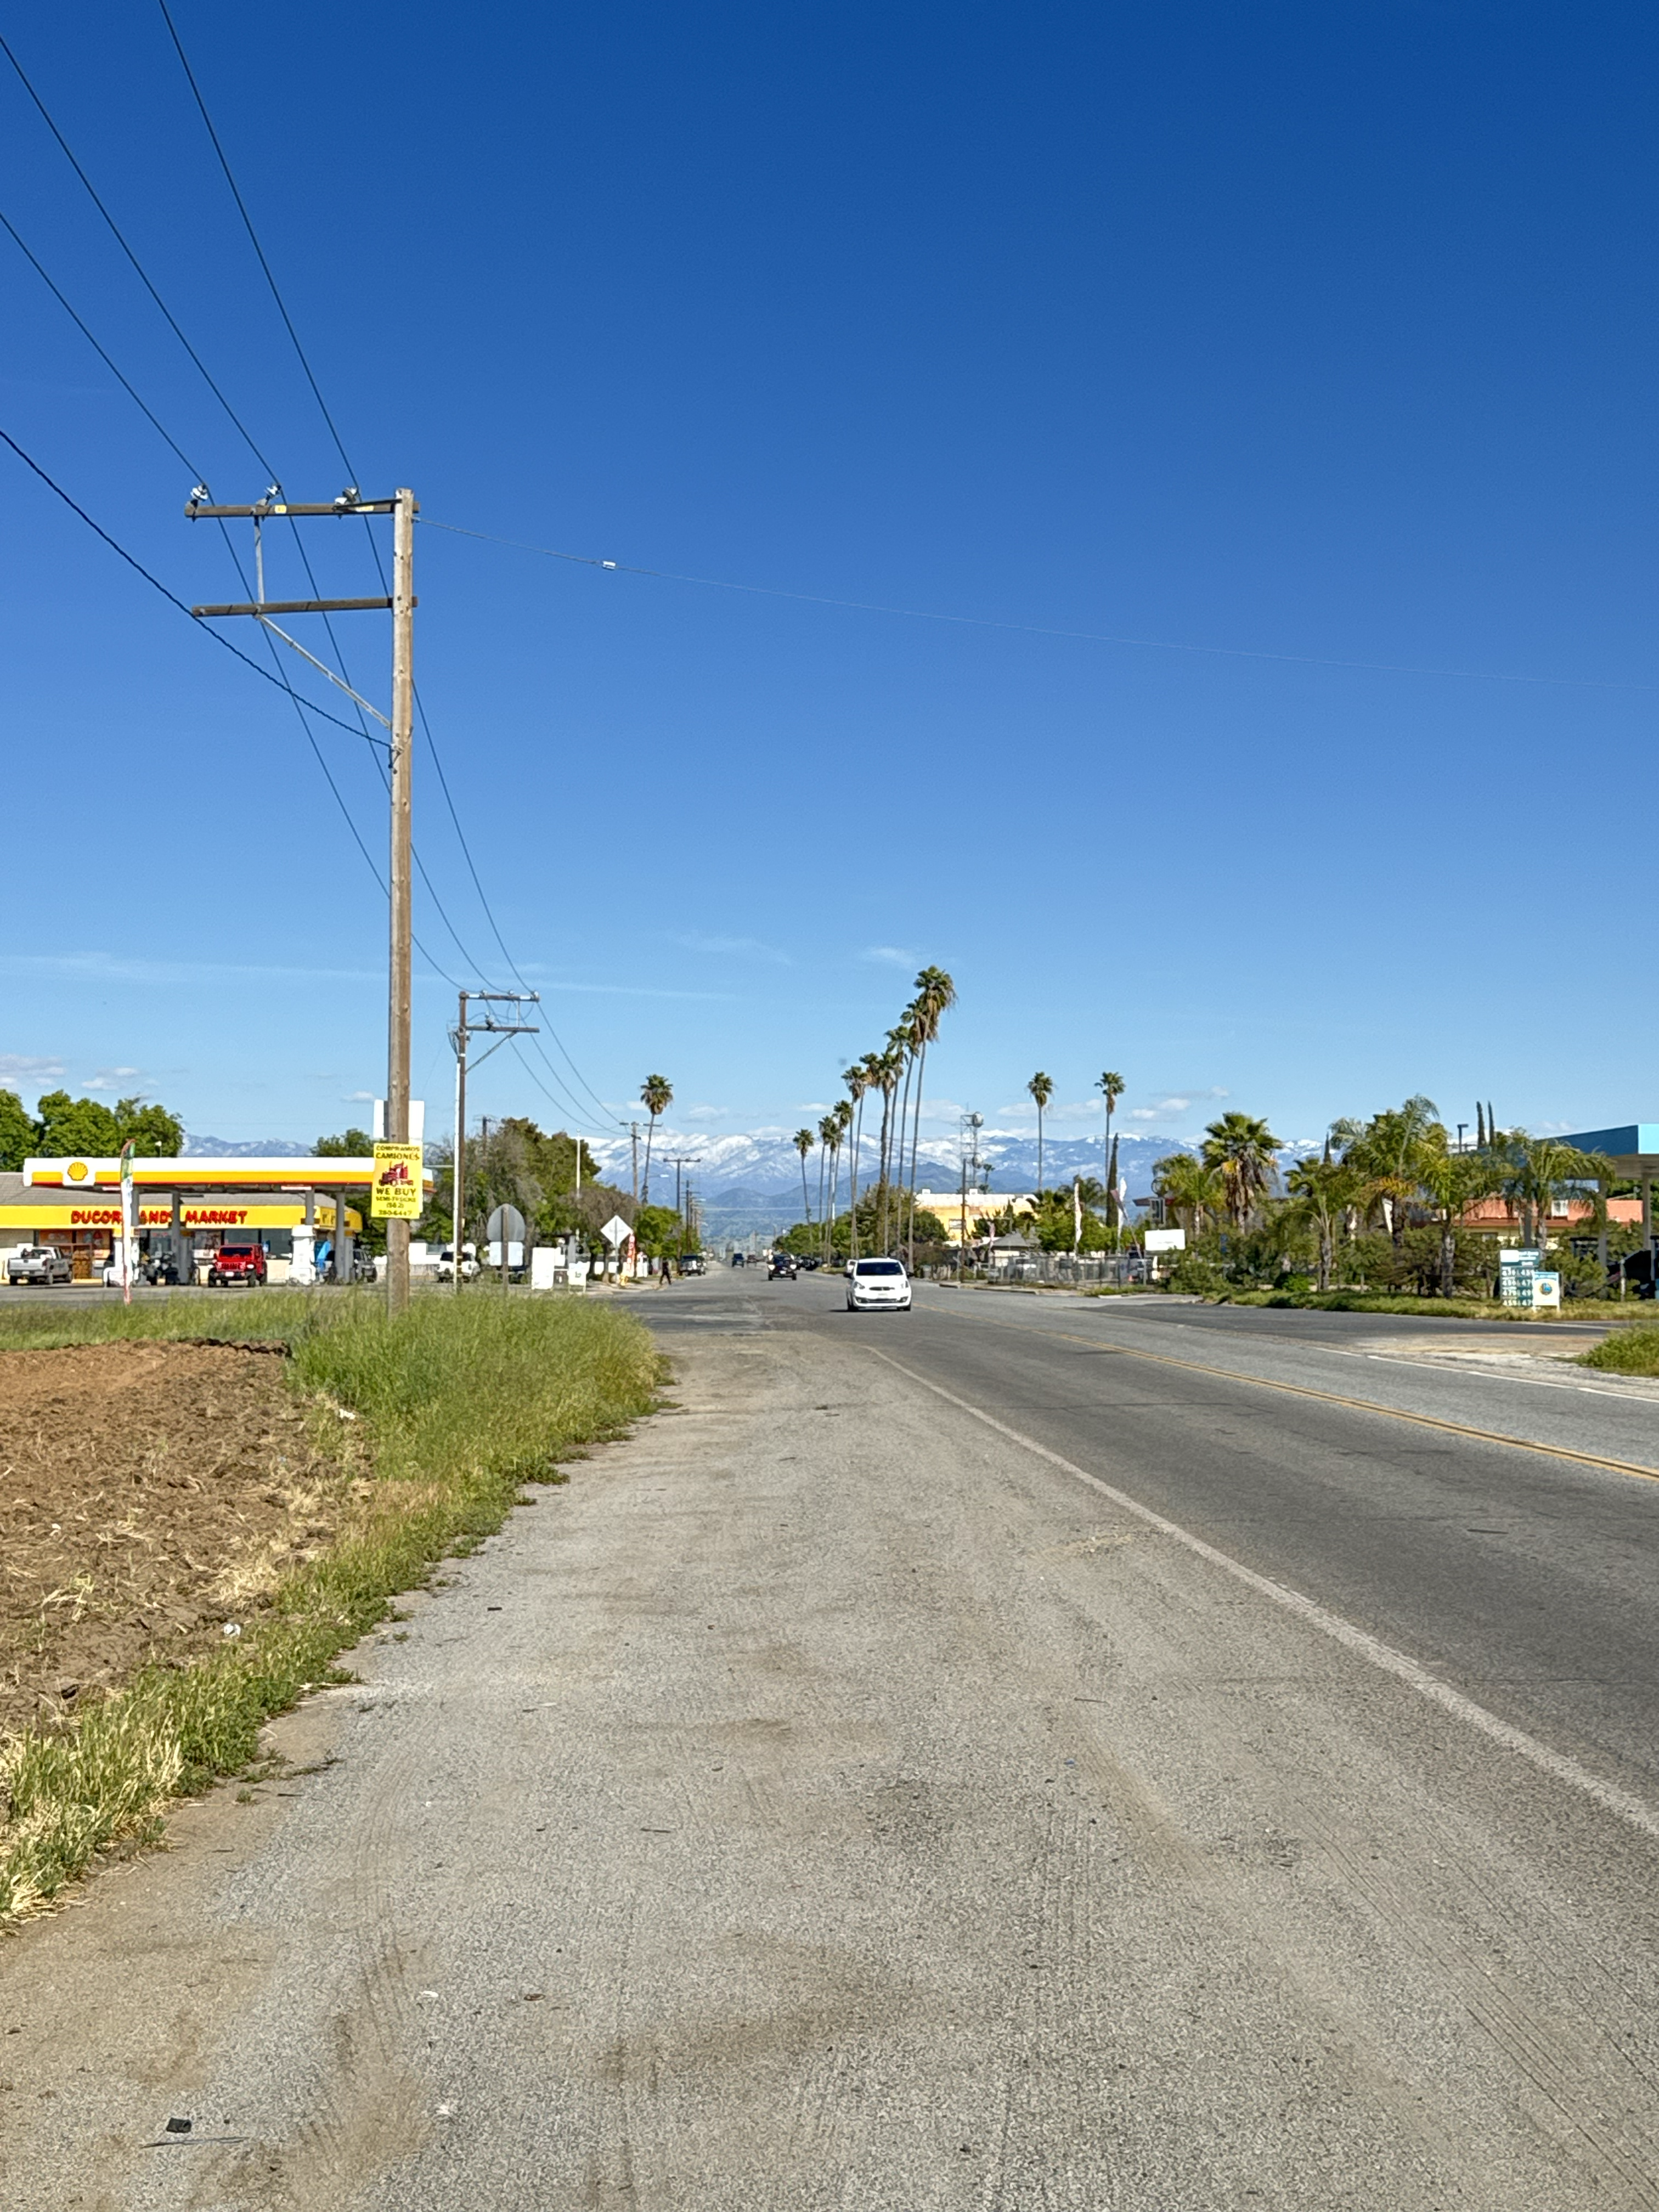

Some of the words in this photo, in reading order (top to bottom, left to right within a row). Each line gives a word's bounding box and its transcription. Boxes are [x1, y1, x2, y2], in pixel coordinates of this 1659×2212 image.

[375, 1152, 420, 1160] CAMIONES
[376, 1187, 391, 1195] WE
[394, 1188, 416, 1197] BUY
[71, 1210, 122, 1224] DUCOR
[184, 1210, 248, 1224] MARKET
